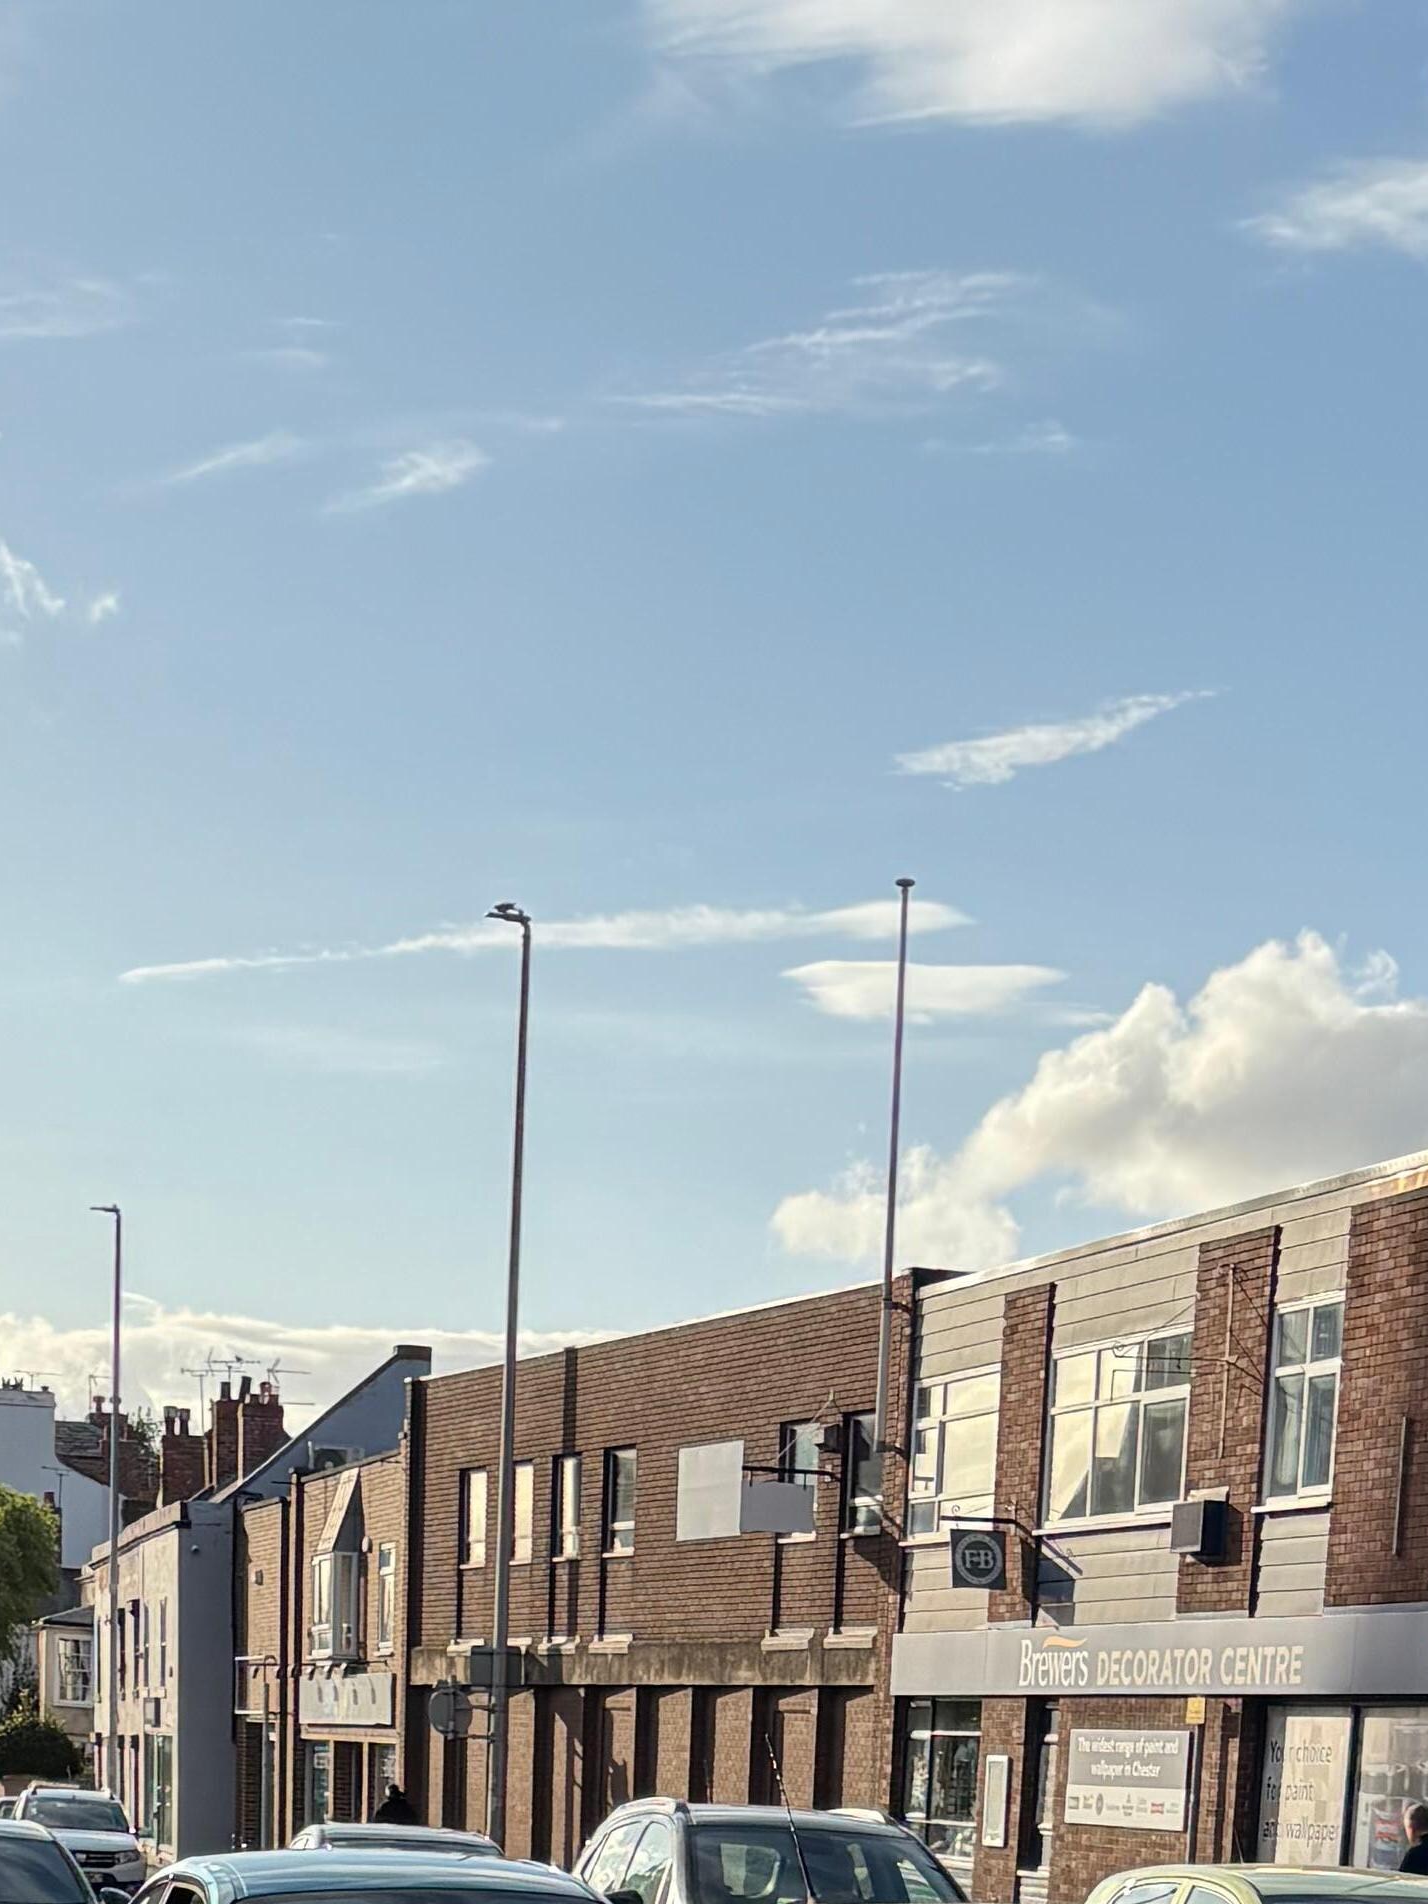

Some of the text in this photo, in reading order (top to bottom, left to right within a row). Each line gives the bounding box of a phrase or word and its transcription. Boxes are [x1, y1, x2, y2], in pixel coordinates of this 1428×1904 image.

[1018, 1638, 1304, 1688] Brewers DECORATOR CENTRE
[1164, 1737, 1179, 1754] and
[1270, 1739, 1333, 1763] Yor choice
[1132, 1760, 1161, 1778] Chester
[1285, 1778, 1315, 1807] paint
[1286, 1815, 1340, 1848] wallpaper
